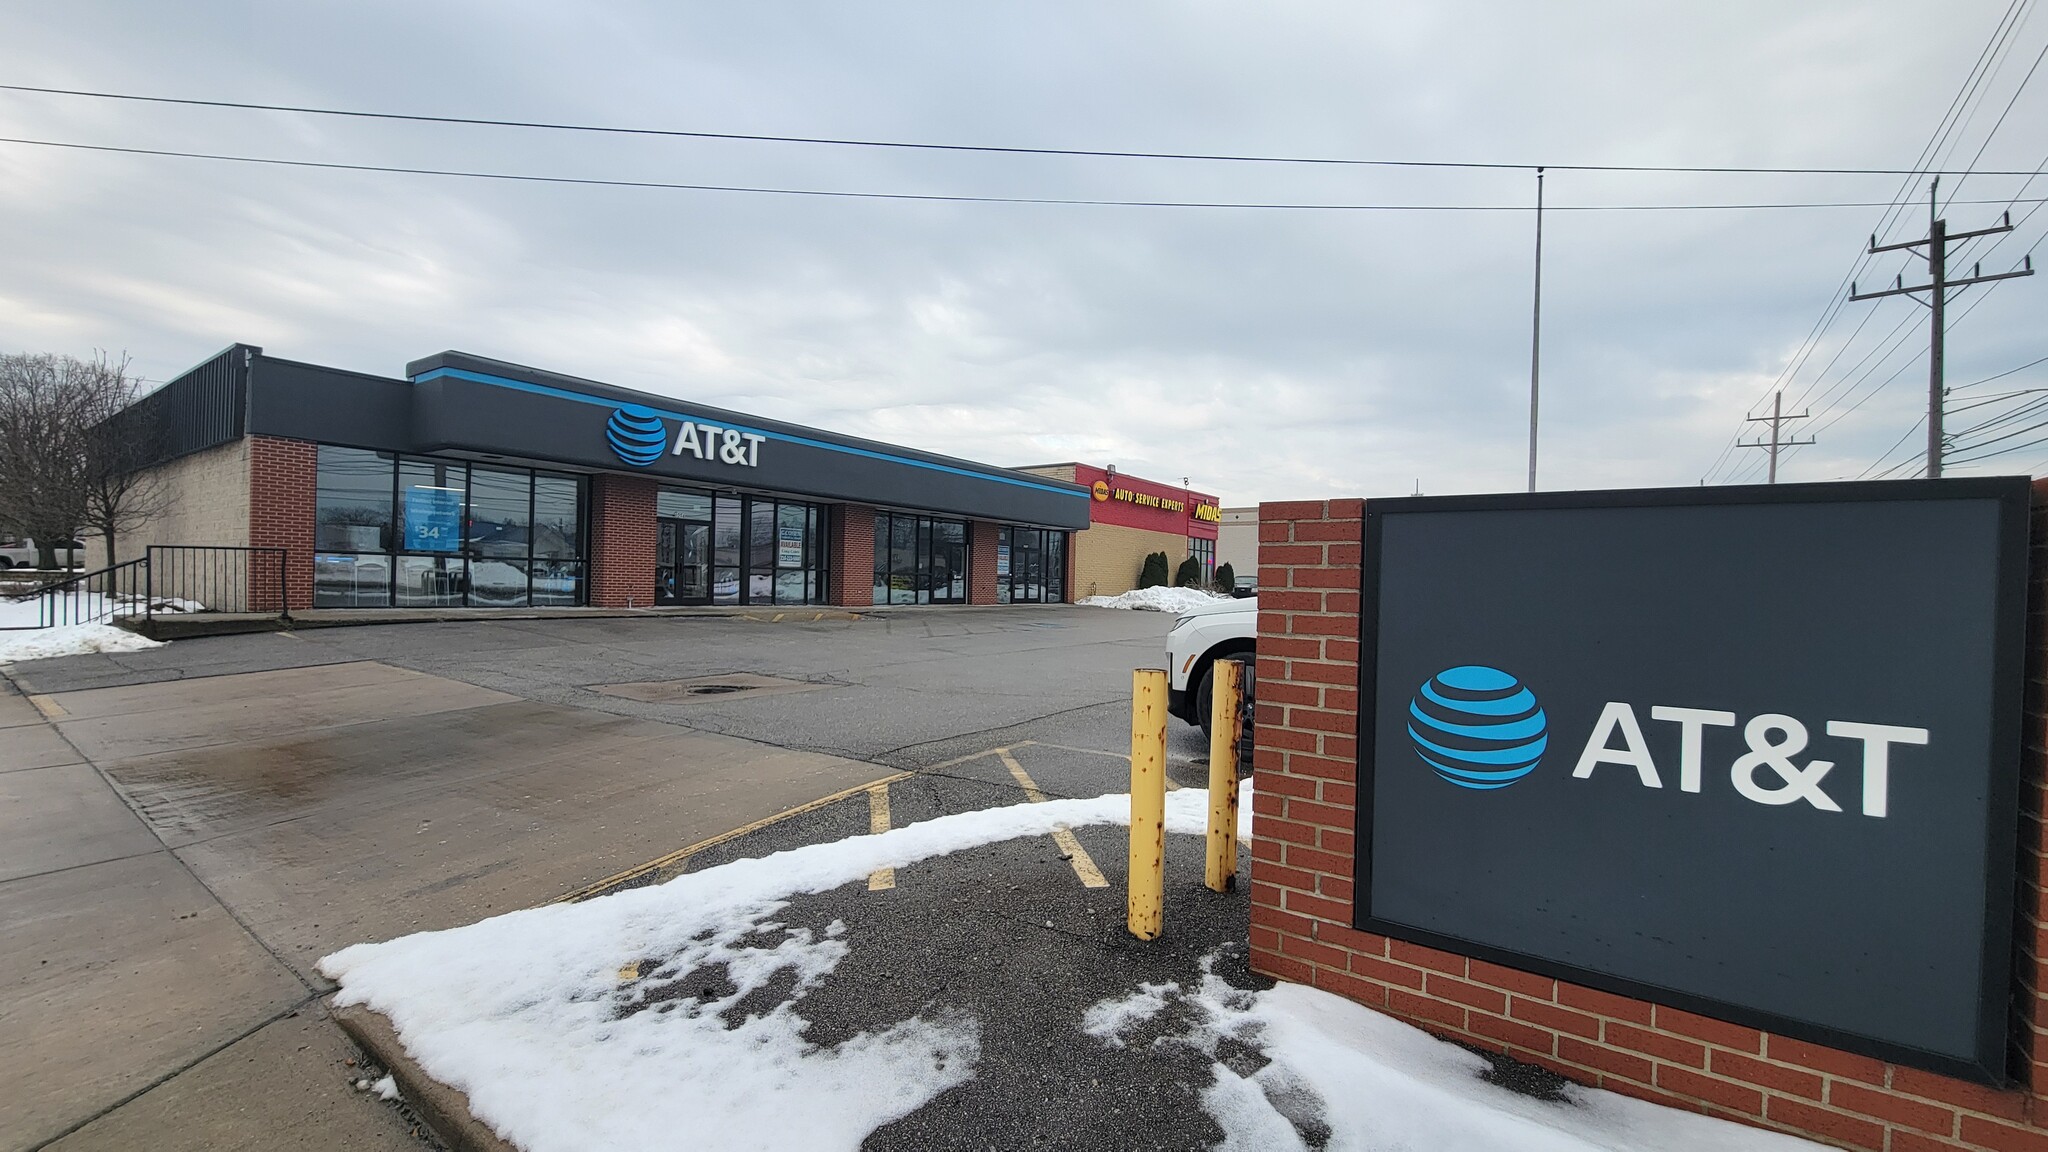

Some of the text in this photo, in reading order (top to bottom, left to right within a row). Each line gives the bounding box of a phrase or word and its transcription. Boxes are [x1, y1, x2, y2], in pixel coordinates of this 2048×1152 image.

[671, 421, 766, 467] AT&T
[1115, 488, 1184, 512] AUTO SERVICE EXPERTS
[1195, 503, 1221, 522] MIDAS
[1572, 701, 1929, 818] AT&T
